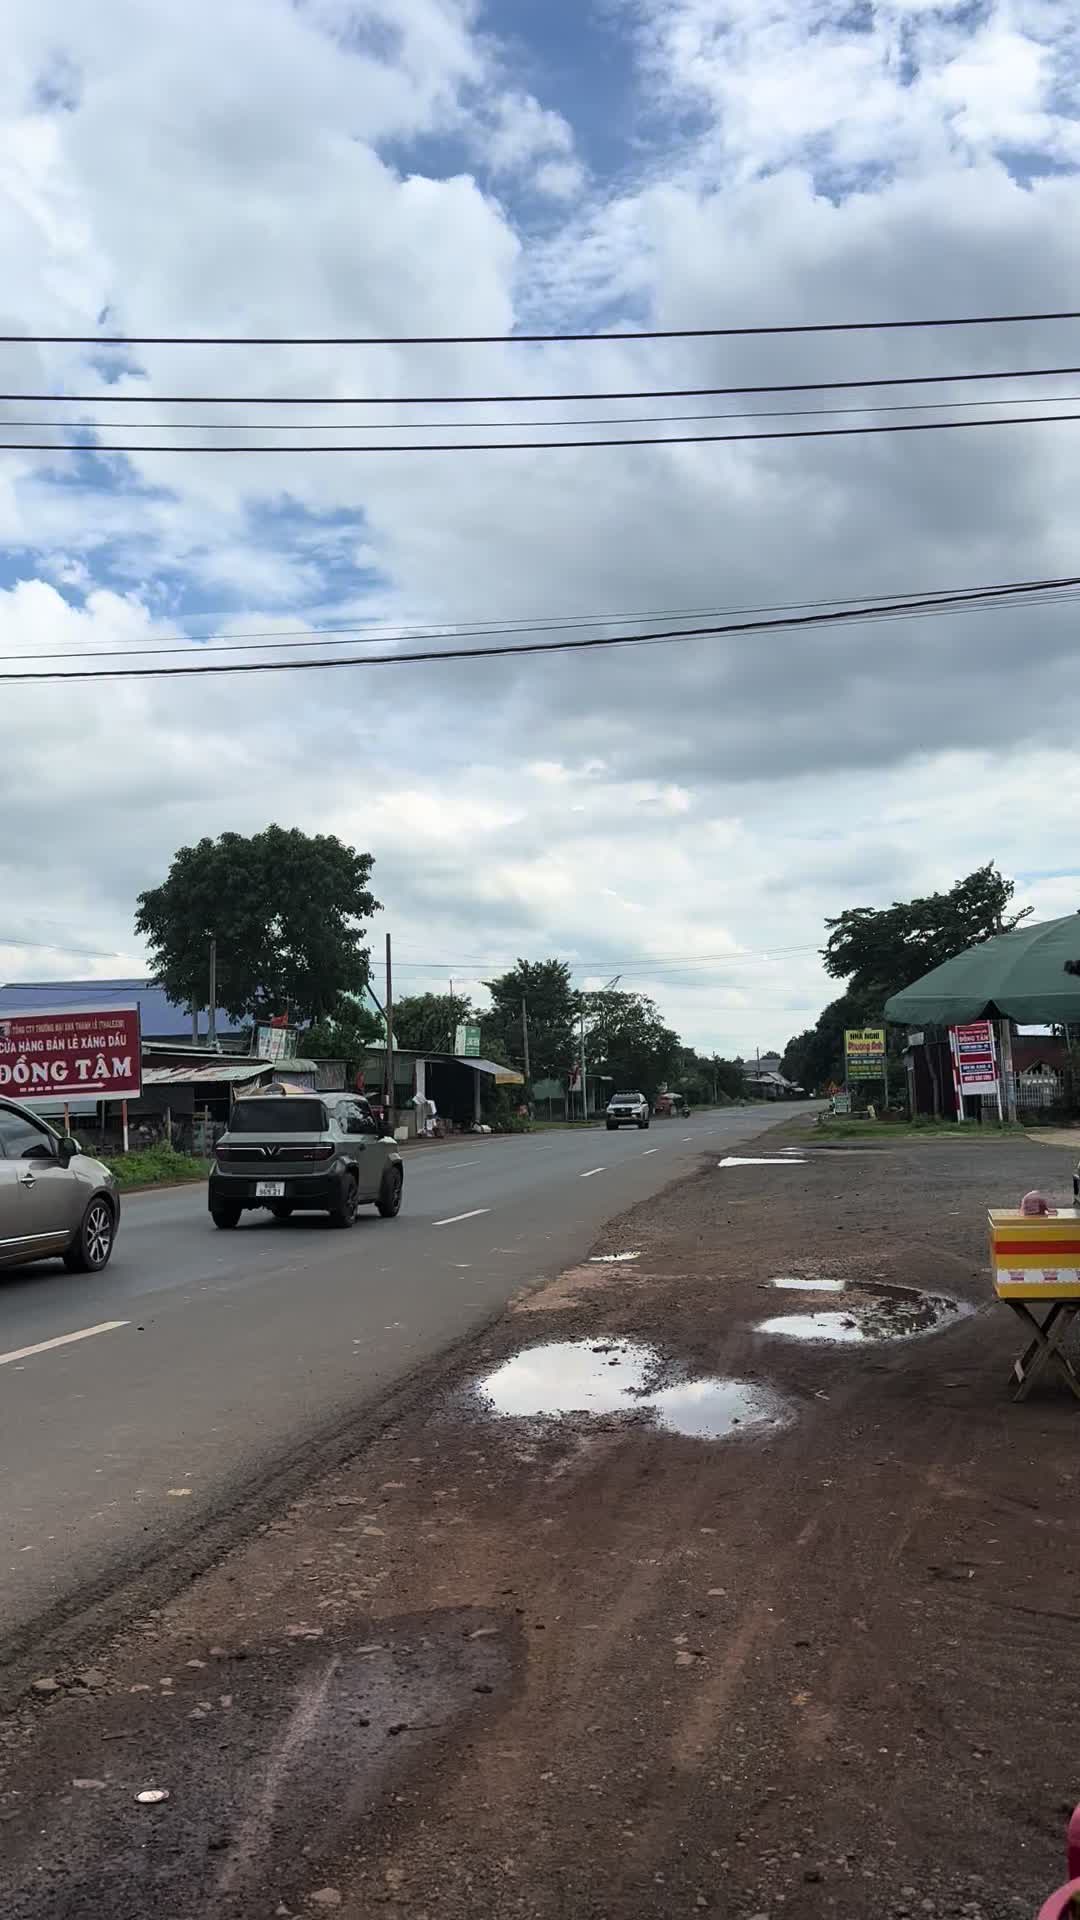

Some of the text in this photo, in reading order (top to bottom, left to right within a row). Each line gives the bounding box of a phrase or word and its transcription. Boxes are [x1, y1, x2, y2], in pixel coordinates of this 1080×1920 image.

[0, 1037, 16, 1053] CỬA
[18, 1038, 44, 1053] HÀNG
[46, 1036, 65, 1051] BÁN
[67, 1034, 79, 1049] LẺ
[81, 1035, 106, 1049] XĂNG
[0, 1053, 133, 1085] ĐỒNG TÂM
